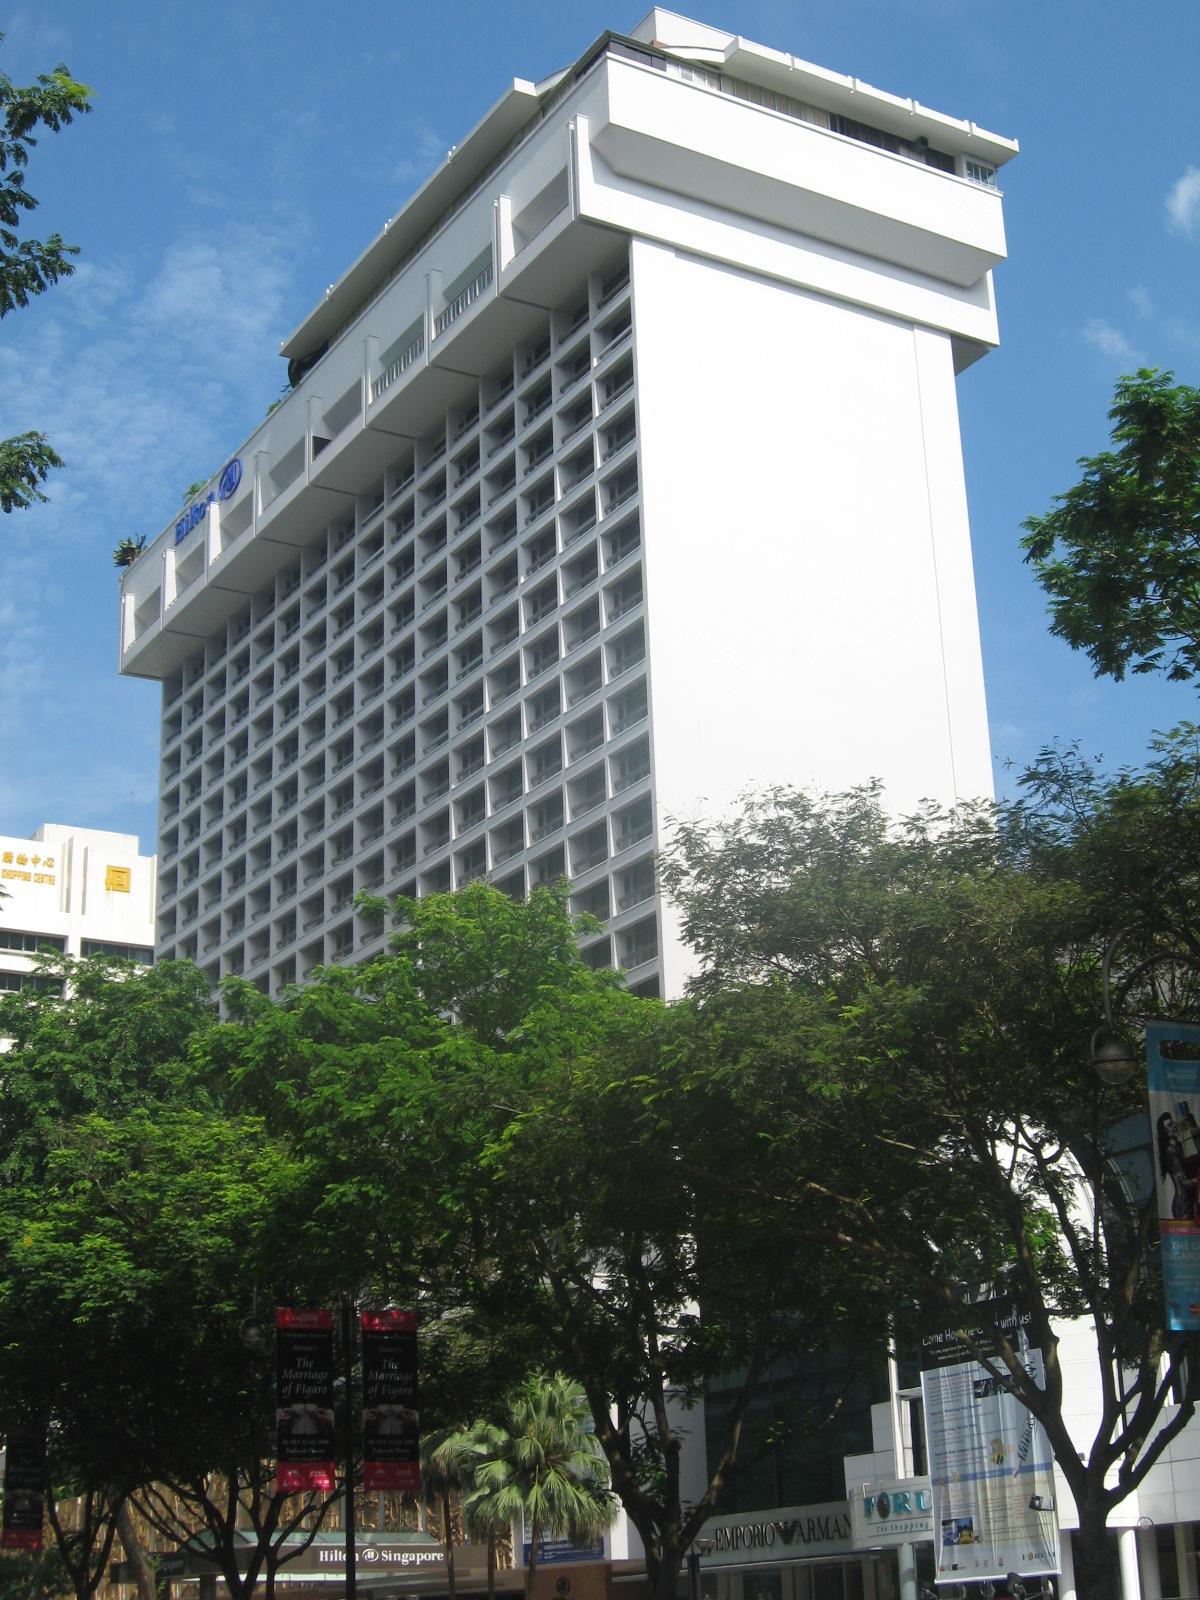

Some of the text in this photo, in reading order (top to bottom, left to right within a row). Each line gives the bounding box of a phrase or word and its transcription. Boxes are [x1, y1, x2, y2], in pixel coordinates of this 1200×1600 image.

[863, 1490, 933, 1519] FORU
[715, 1513, 852, 1551] EMPORIO ARMAN
[381, 1550, 444, 1565] Singapore
